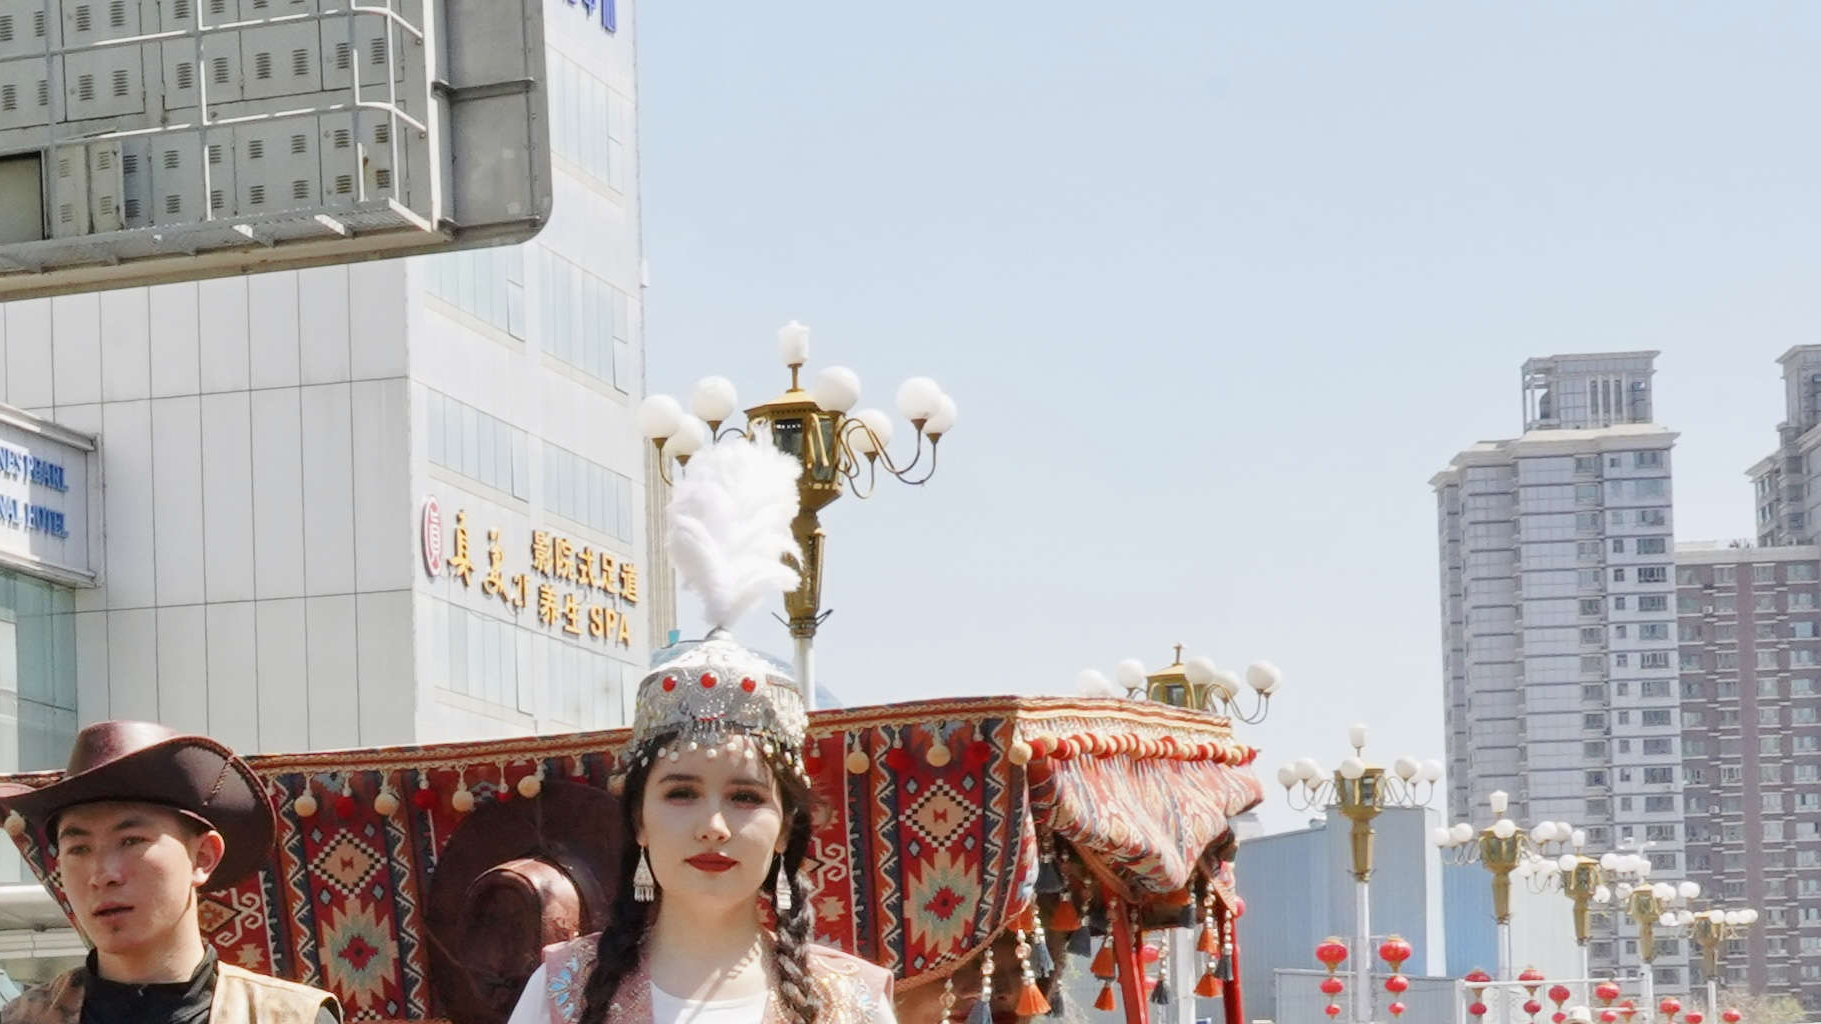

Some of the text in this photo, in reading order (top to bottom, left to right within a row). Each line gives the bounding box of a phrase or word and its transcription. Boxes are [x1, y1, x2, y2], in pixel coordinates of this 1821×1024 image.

[23, 453, 68, 492] PEARL
[24, 503, 68, 538] HOTEL
[531, 529, 639, 603] 影院式足道
